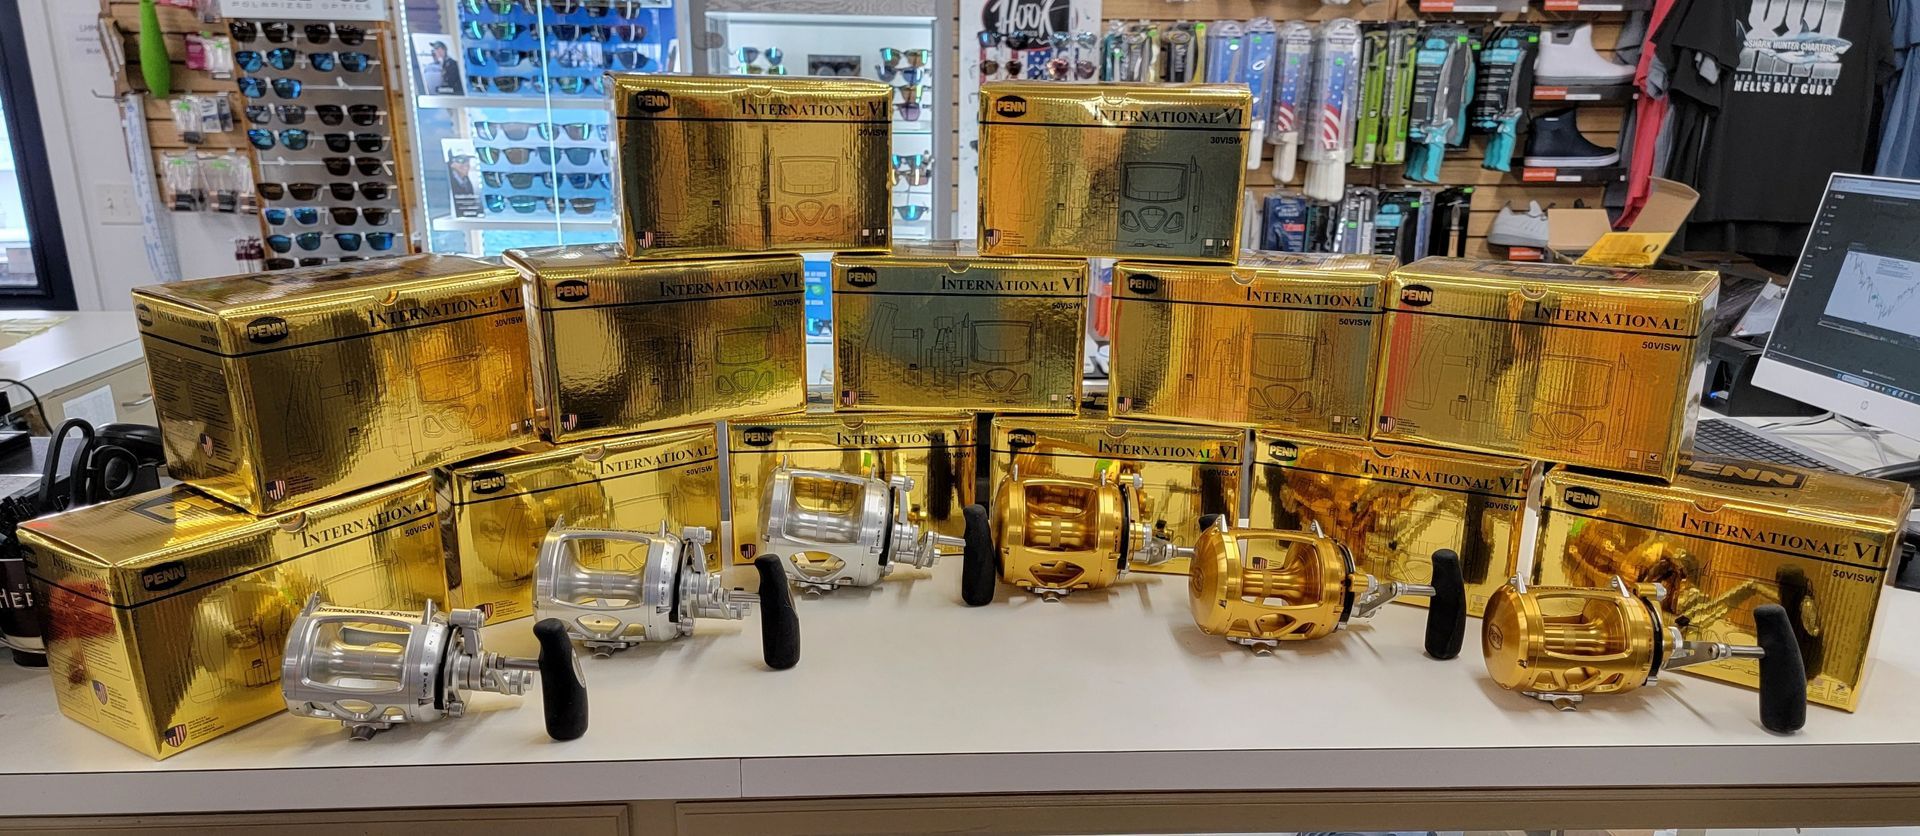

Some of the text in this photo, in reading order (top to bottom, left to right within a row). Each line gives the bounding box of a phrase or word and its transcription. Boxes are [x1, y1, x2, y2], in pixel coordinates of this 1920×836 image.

[1747, 40, 1837, 54] SHARK HUNTER CHARTERS
[1734, 80, 1771, 93] HELL'S
[1773, 82, 1797, 94] BAY
[1800, 83, 1832, 96] CUBA
[637, 94, 670, 107] PENN
[742, 98, 888, 117] INTERNATIONAL VI
[997, 101, 1026, 113] PENN
[1093, 104, 1243, 124] INTERNATIONAL VI
[1210, 136, 1243, 145] 30VISW
[660, 272, 799, 297] INTERNATIONAL VI
[848, 272, 877, 284] PENN
[941, 275, 1081, 292] INTERNATIONAL VI
[1129, 279, 1158, 291] PENN
[556, 285, 588, 298] PENN
[1246, 286, 1373, 308] INTERNATIONAL
[1401, 289, 1432, 302] PENN
[369, 287, 521, 329] INTERNATIONAL VI
[1534, 301, 1684, 330] INTERNATIONAL
[494, 315, 523, 328] 30VISW
[1339, 317, 1372, 327] 50VISW
[248, 320, 288, 341] PENN
[1641, 341, 1682, 352] 50VISW
[745, 432, 773, 442] PENN
[837, 429, 971, 446] INTERNATIONAL VI
[1008, 433, 1036, 444] PENN
[1098, 439, 1238, 460] INTERNATIONAL VI
[1269, 445, 1299, 459] PENN
[600, 446, 711, 475] INTERNATIONAL
[686, 465, 713, 477] 50VISW
[1363, 459, 1520, 494] INTERNATIONAL VI
[472, 476, 505, 491] PENN
[1565, 489, 1600, 507] PENN
[1484, 501, 1519, 512] 50VISW
[300, 500, 433, 549] INTERNATIONAL
[404, 521, 436, 538] 50VISW
[1680, 512, 1881, 563] INTERNATIONAL VI
[143, 564, 186, 588] PENN
[1832, 569, 1878, 584] 50VISW
[318, 606, 385, 616] INTERNATIONAL
